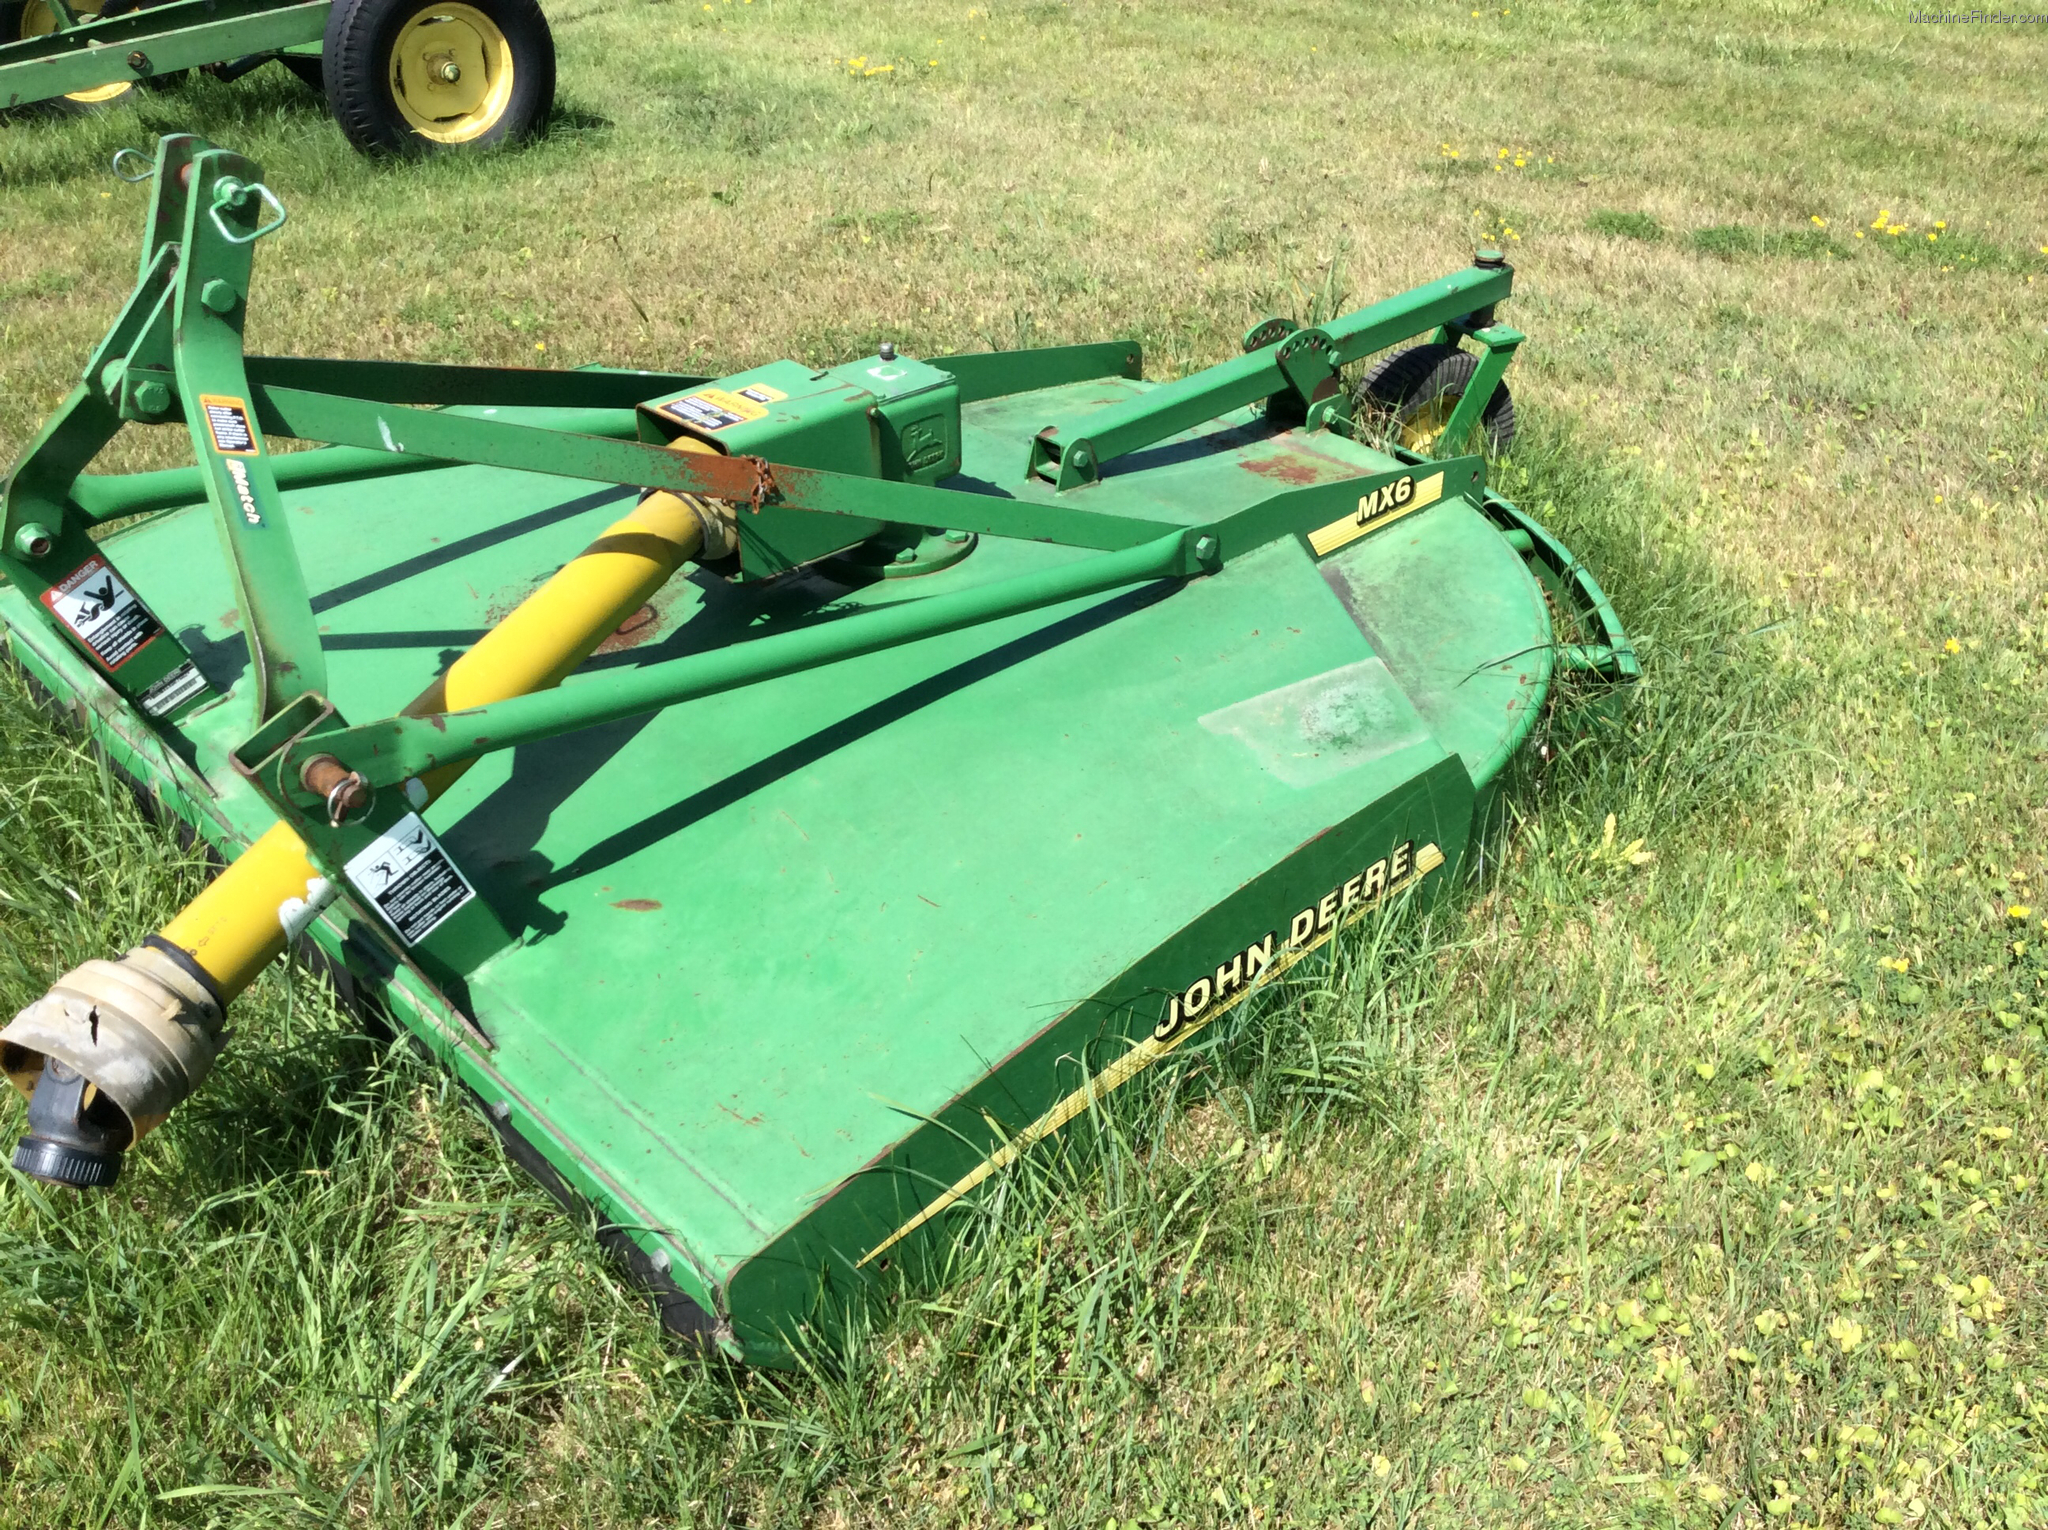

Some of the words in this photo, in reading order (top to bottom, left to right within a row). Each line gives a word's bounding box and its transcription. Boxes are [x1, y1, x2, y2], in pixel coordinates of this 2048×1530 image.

[1356, 475, 1415, 526] MX6
[58, 560, 98, 593] DANGER
[1154, 930, 1277, 1041] JOHN
[1290, 840, 1413, 948] DEERE
